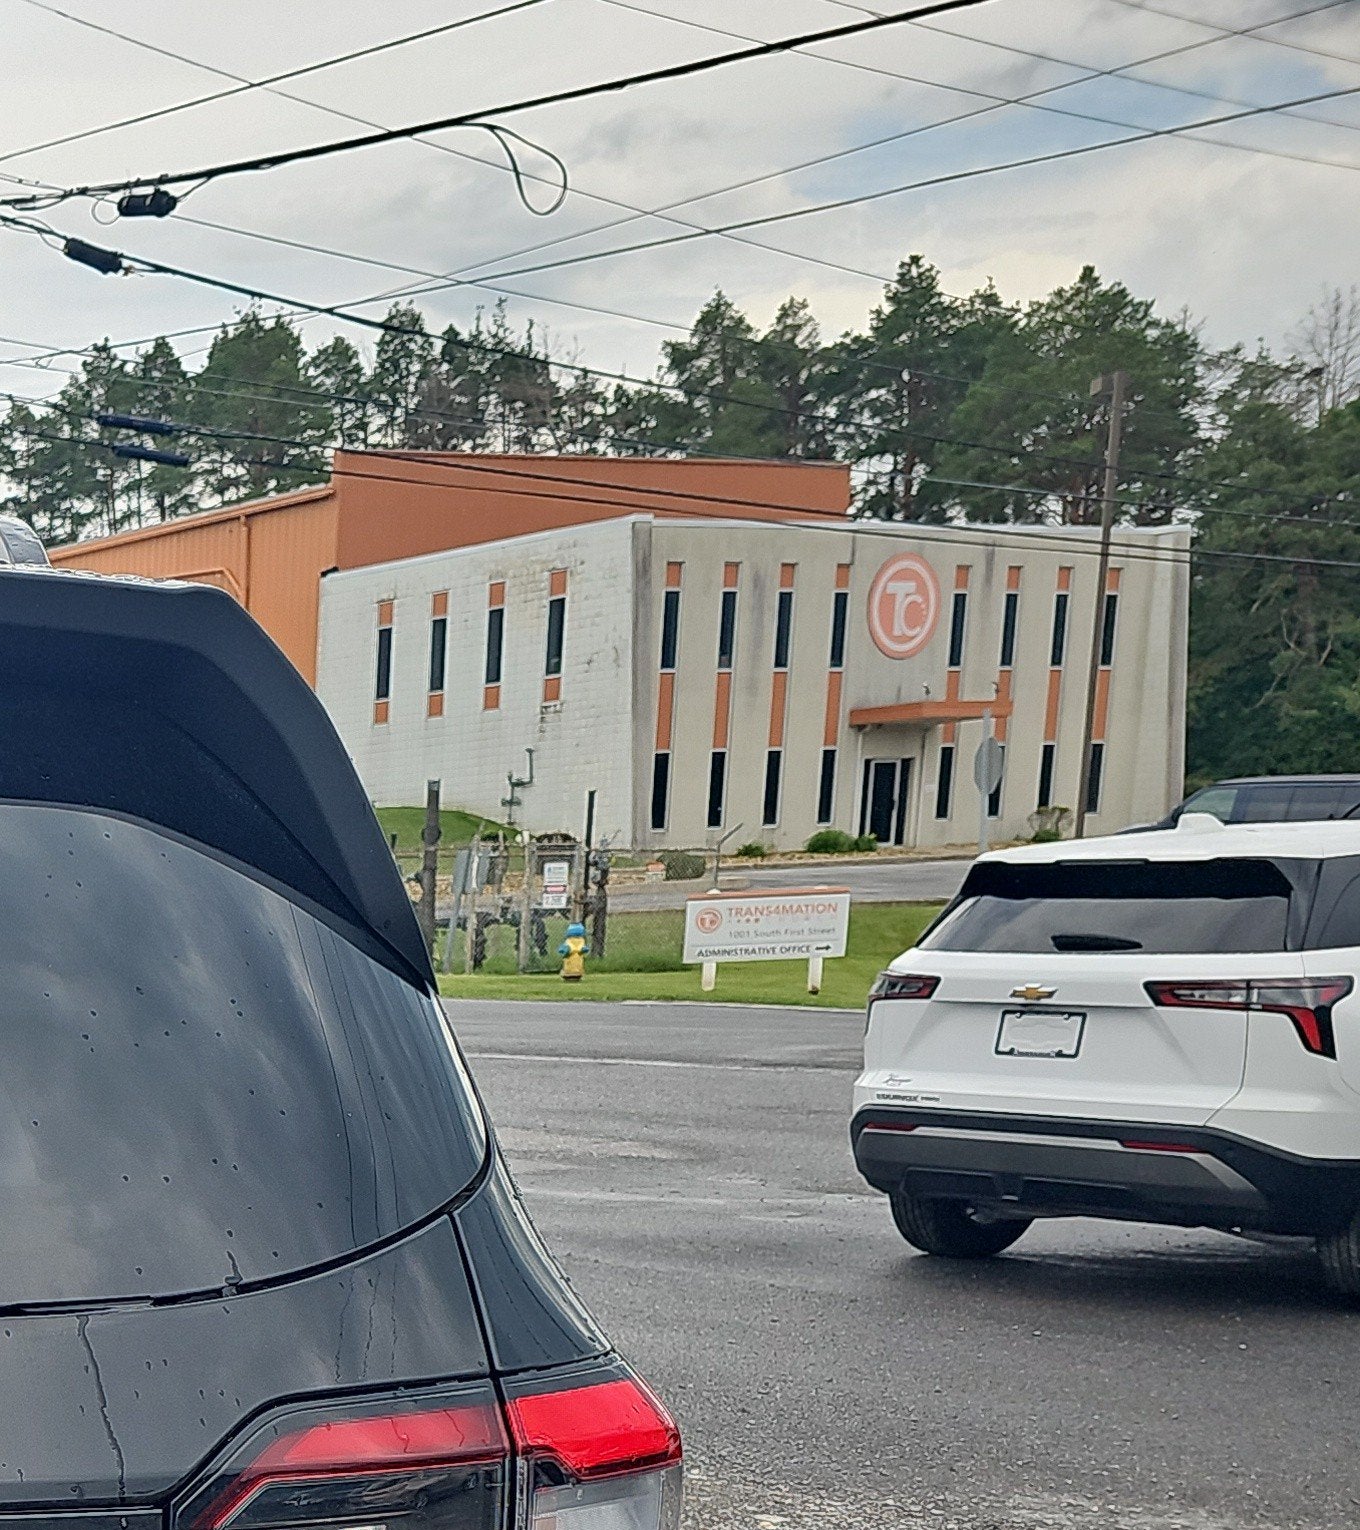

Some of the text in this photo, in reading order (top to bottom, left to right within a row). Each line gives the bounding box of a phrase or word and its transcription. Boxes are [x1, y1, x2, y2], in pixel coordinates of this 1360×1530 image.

[728, 903, 838, 917] TRANS4MATION
[754, 927, 780, 936] South
[784, 926, 804, 935] First
[808, 924, 836, 934] Street
[697, 945, 811, 957] ADMINISTRATIVE OFFICE
